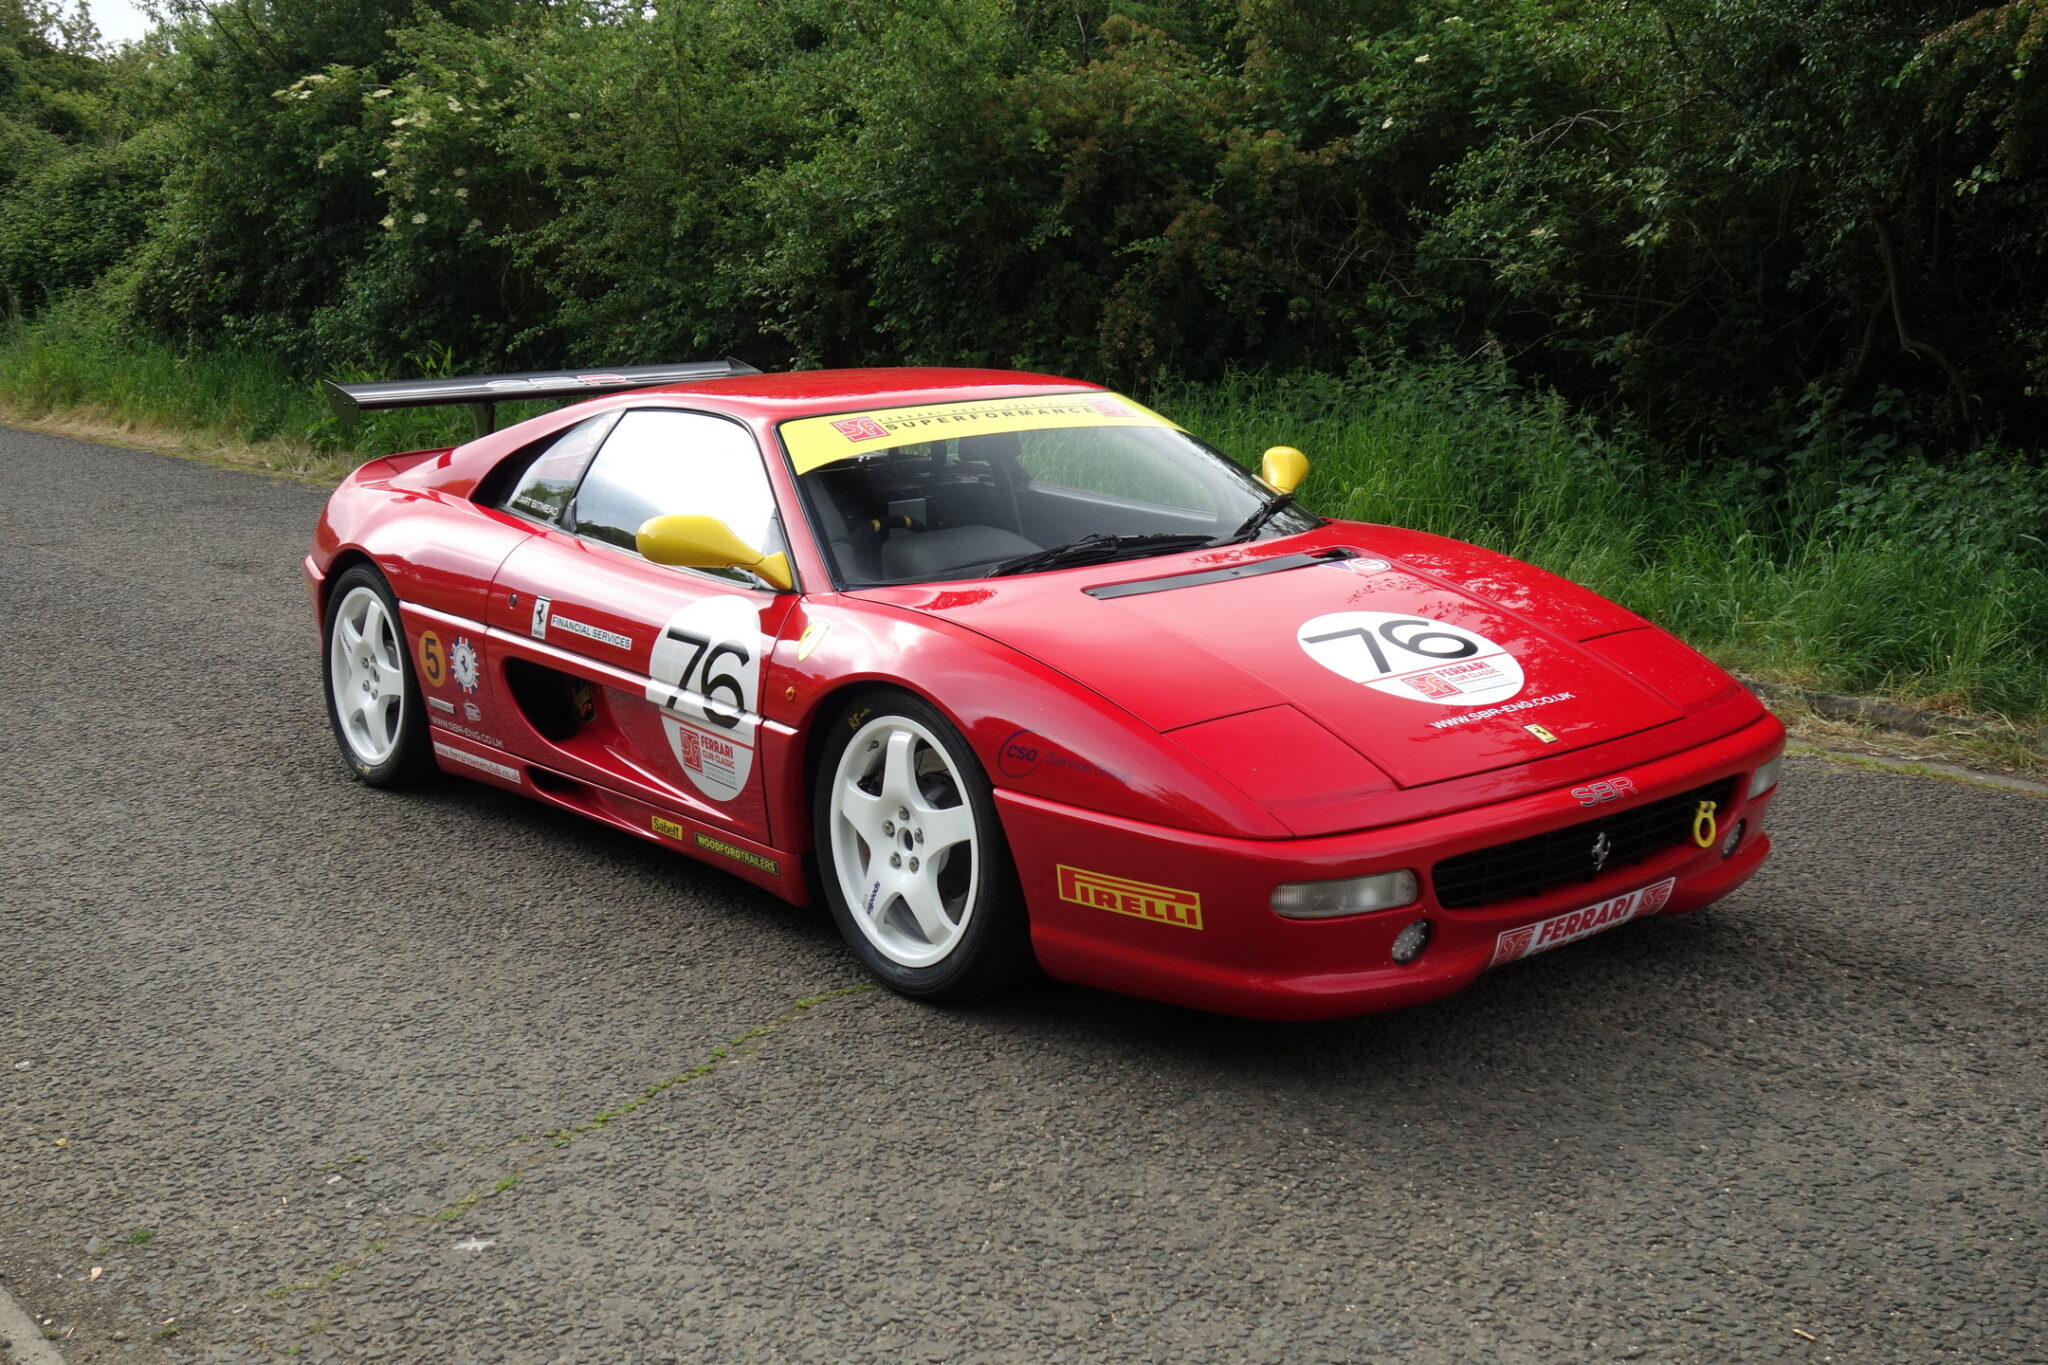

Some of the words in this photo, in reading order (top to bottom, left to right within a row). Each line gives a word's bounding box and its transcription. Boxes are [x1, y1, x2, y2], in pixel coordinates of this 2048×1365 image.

[886, 407, 1096, 430] SUPERFORMANCE
[553, 616, 591, 636] FINANCIAL
[592, 628, 630, 648] SERVICES
[1302, 619, 1479, 673] 76
[425, 637, 440, 680] 5
[1436, 661, 1491, 677] FERRARI
[666, 625, 750, 729] 76
[1431, 691, 1576, 729] WWW.SBR-ENG.CO.UK
[701, 735, 734, 759] FERRARI
[1047, 752, 1092, 772] Service
[1571, 776, 1638, 807] SBR
[653, 818, 680, 839] Sabelt
[1059, 867, 1198, 926] PIRELLI
[1537, 893, 1635, 946] FERRARI
